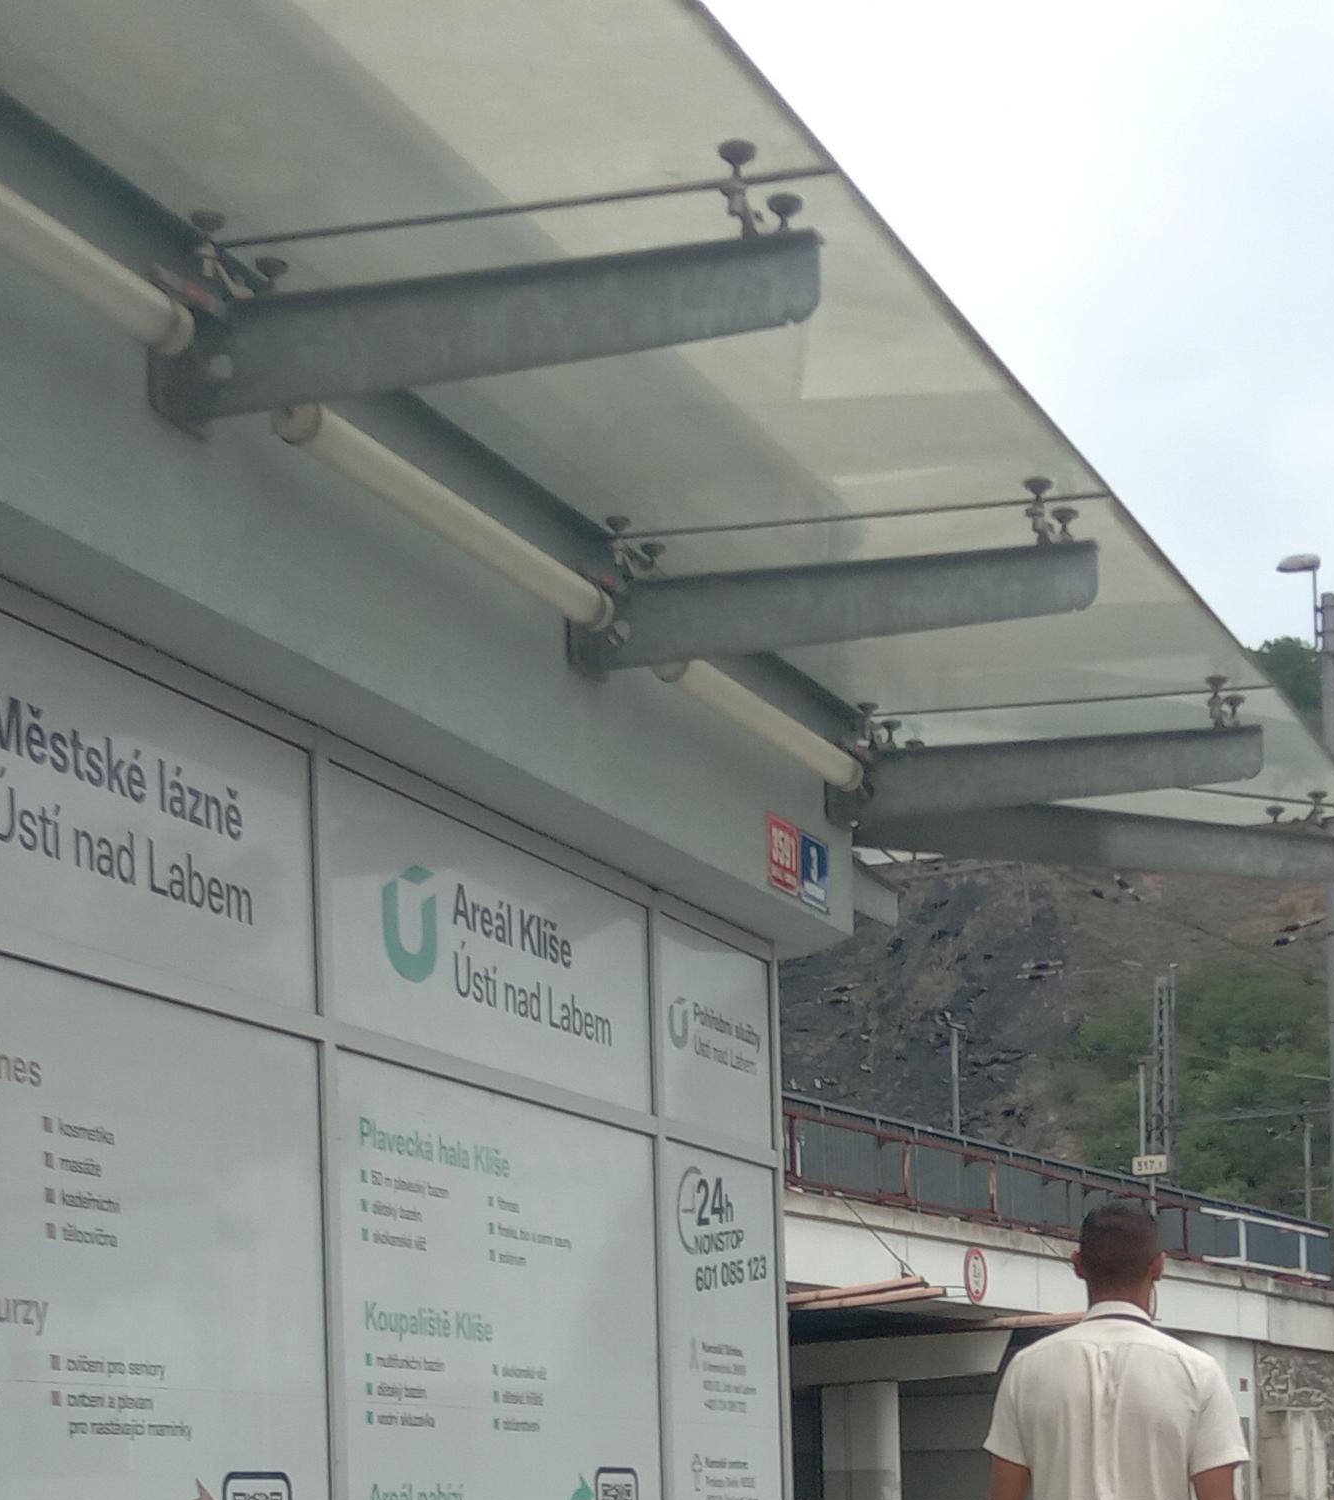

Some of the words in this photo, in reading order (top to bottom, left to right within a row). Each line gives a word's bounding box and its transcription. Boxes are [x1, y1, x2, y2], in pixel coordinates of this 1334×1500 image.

[158, 758, 243, 841] lázně
[73, 828, 136, 886] nad
[147, 838, 254, 926] Labem
[452, 882, 512, 946] Areál
[520, 908, 573, 970] Klíše
[454, 941, 497, 1008] Ústí
[504, 982, 541, 1024] nad
[547, 986, 612, 1047] Labem
[359, 1116, 435, 1161] Plavecká
[438, 1134, 469, 1170] hala
[696, 1177, 734, 1226] 24h
[694, 1229, 744, 1254] NONSTOP
[695, 1264, 717, 1291] 601
[747, 1255, 767, 1281] 123
[365, 1301, 451, 1342] Koupaliště
